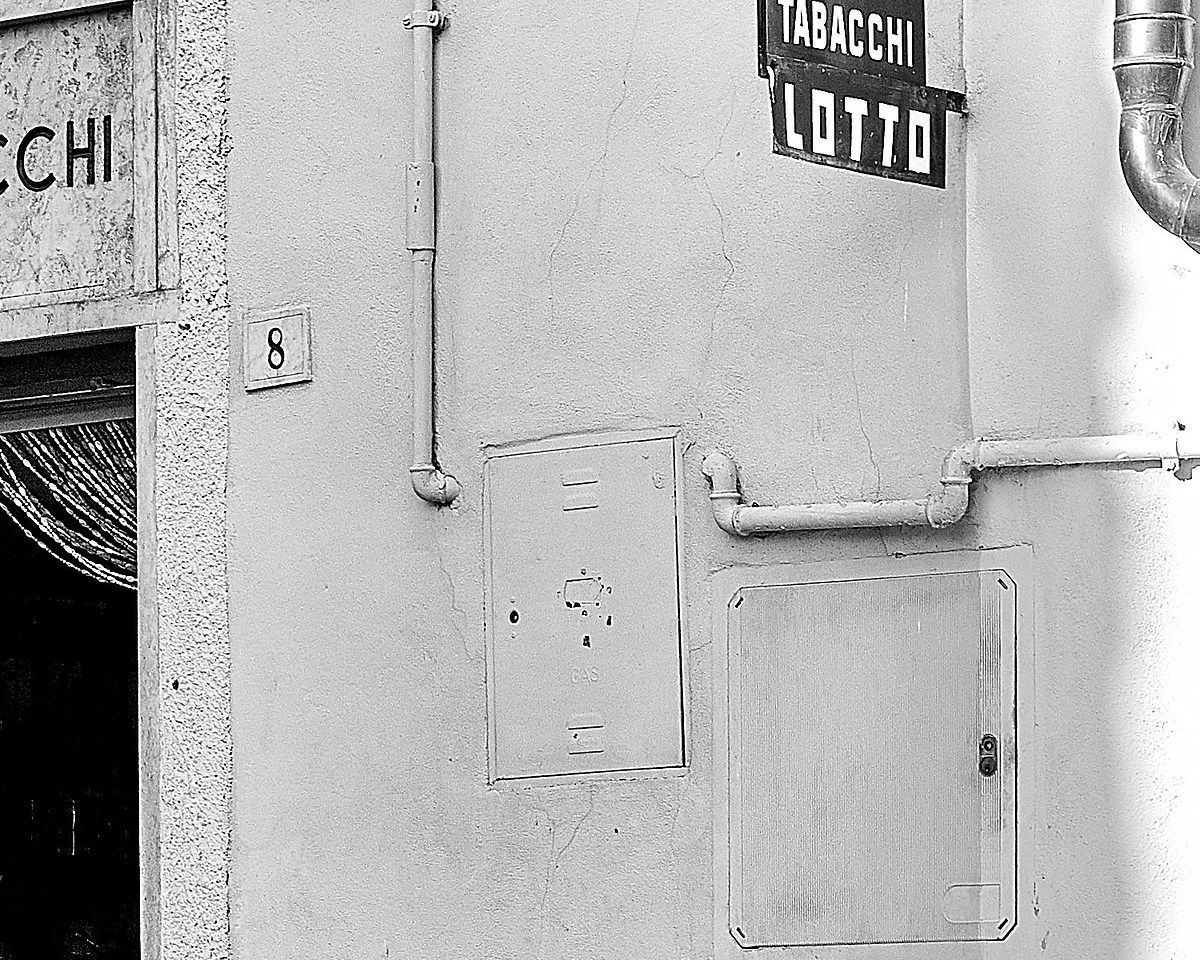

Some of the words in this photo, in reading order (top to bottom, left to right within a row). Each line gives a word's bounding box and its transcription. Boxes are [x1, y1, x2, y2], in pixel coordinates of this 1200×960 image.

[777, 0, 914, 68] TABACCHI
[784, 82, 931, 175] LOTTO
[267, 327, 285, 370] 8
